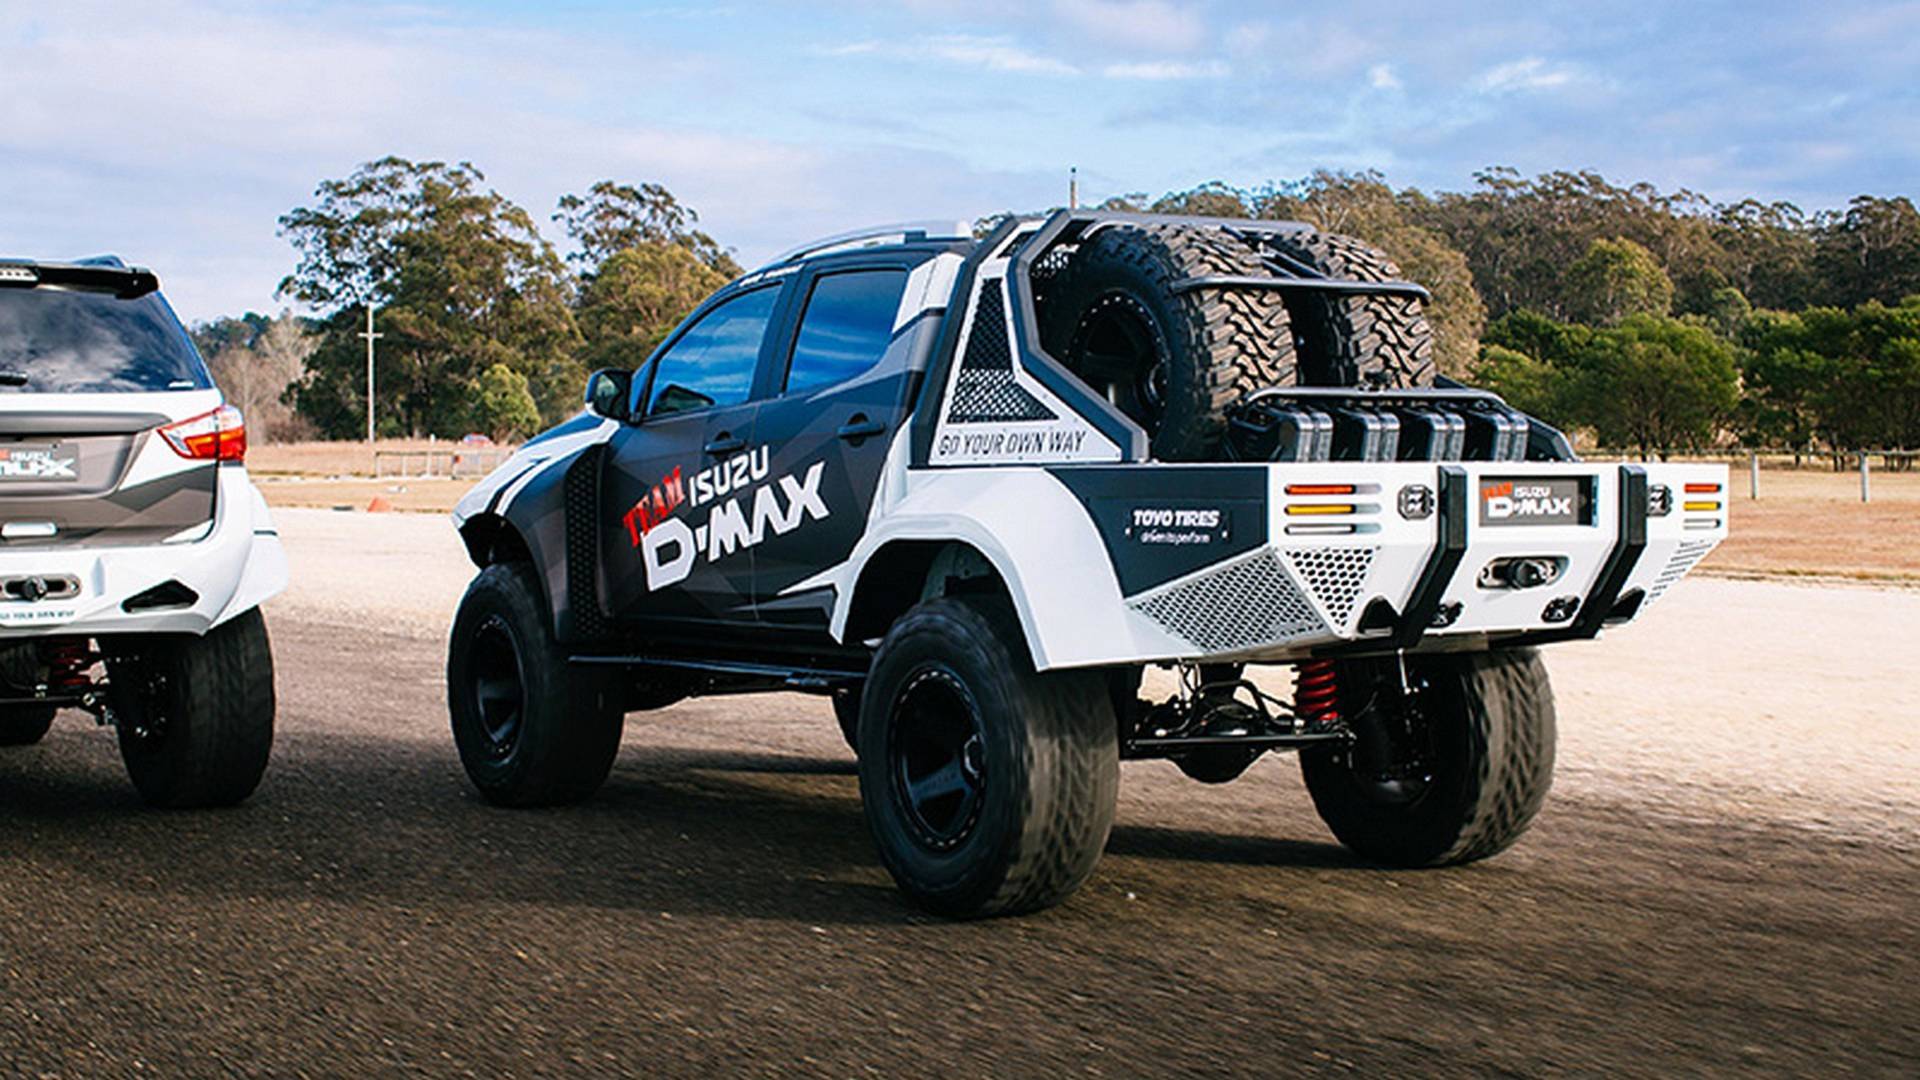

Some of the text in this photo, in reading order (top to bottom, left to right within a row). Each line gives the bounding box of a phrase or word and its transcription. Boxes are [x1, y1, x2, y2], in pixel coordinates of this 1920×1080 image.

[939, 430, 1086, 455] GO YOUR OWN WAY
[689, 444, 769, 507] ISUZU
[1514, 486, 1552, 498] ISUZU
[1133, 509, 1220, 527] TOYO TIRES
[1487, 497, 1571, 518] D-MAX
[640, 461, 830, 592] D-MAX
